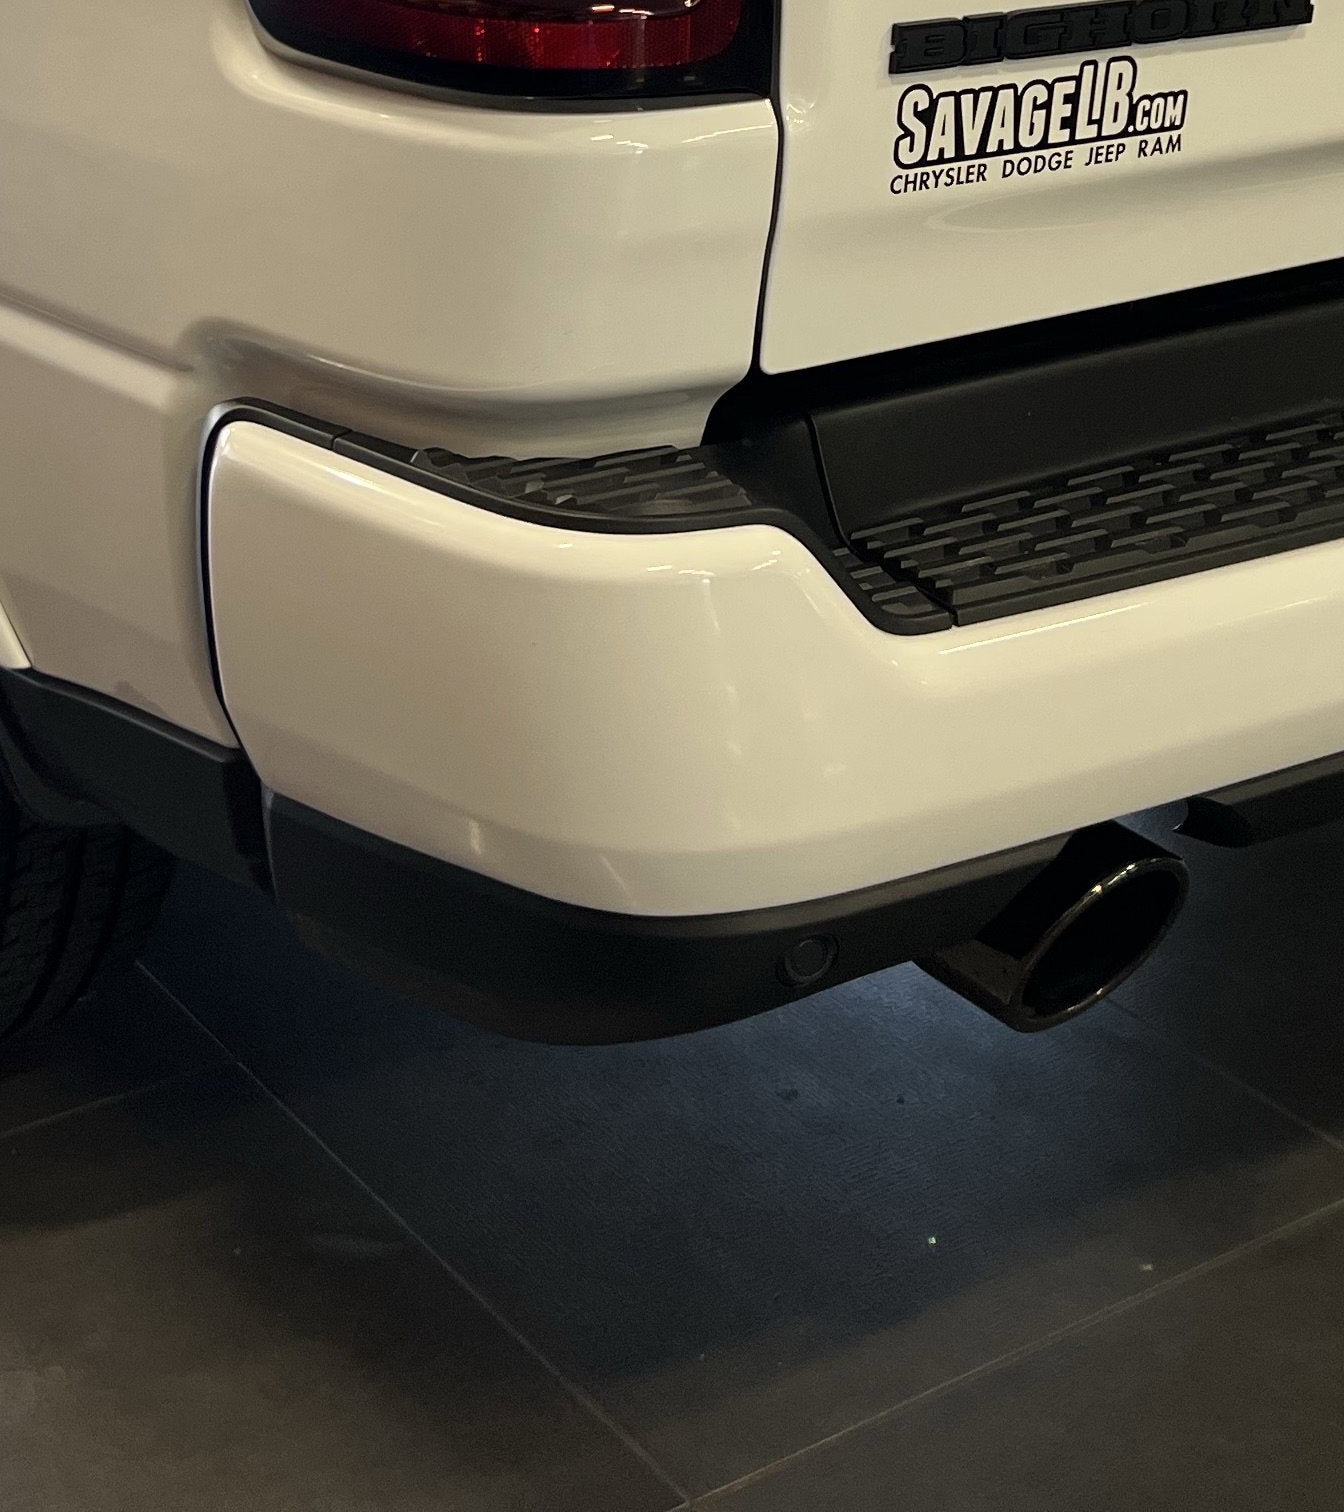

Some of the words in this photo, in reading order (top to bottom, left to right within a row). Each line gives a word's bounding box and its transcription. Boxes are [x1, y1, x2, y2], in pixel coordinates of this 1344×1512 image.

[890, 163, 987, 195] CHRYSLER
[1001, 150, 1074, 178] DODGE
[1084, 143, 1126, 166] JEEP
[1137, 133, 1183, 158] RAM
